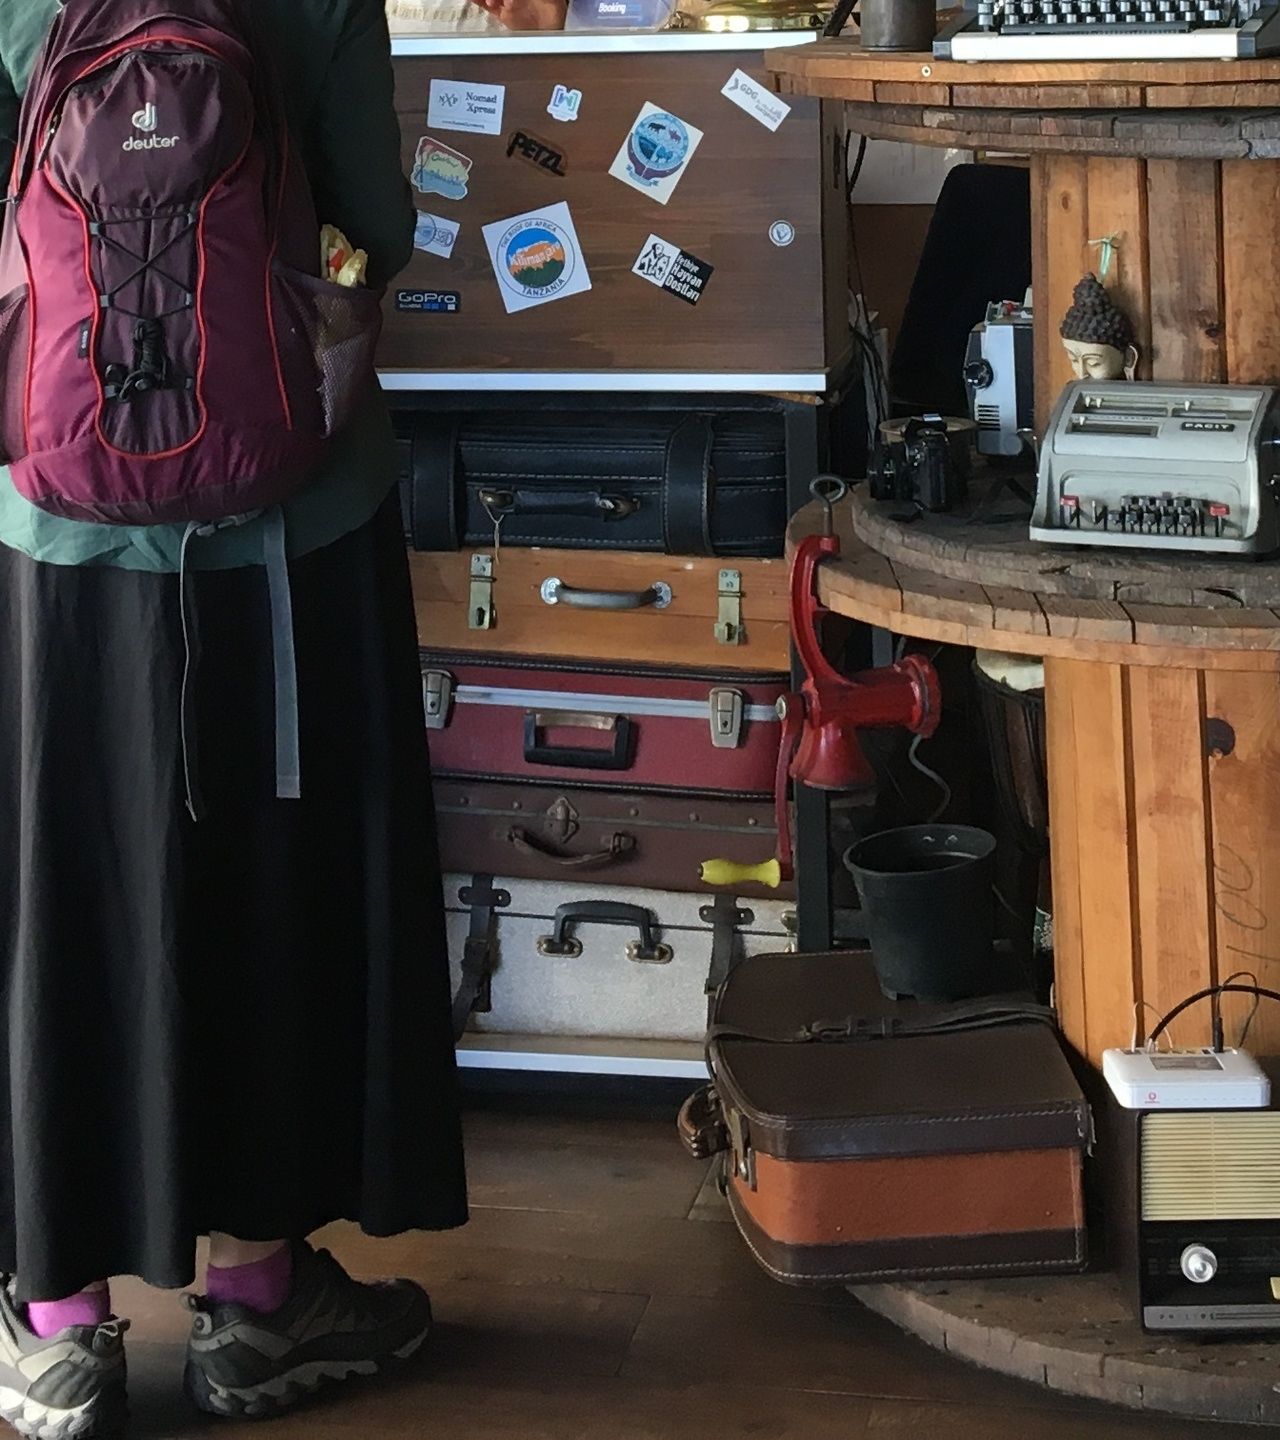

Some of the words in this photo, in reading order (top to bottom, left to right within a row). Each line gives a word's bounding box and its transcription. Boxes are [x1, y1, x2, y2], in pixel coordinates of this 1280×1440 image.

[465, 92, 498, 105] Nomad
[466, 103, 496, 114] Xpress
[122, 134, 180, 151] deuter
[671, 264, 703, 288] Hayvan
[522, 278, 566, 296] TANZANIA
[398, 292, 456, 303] GoPro
